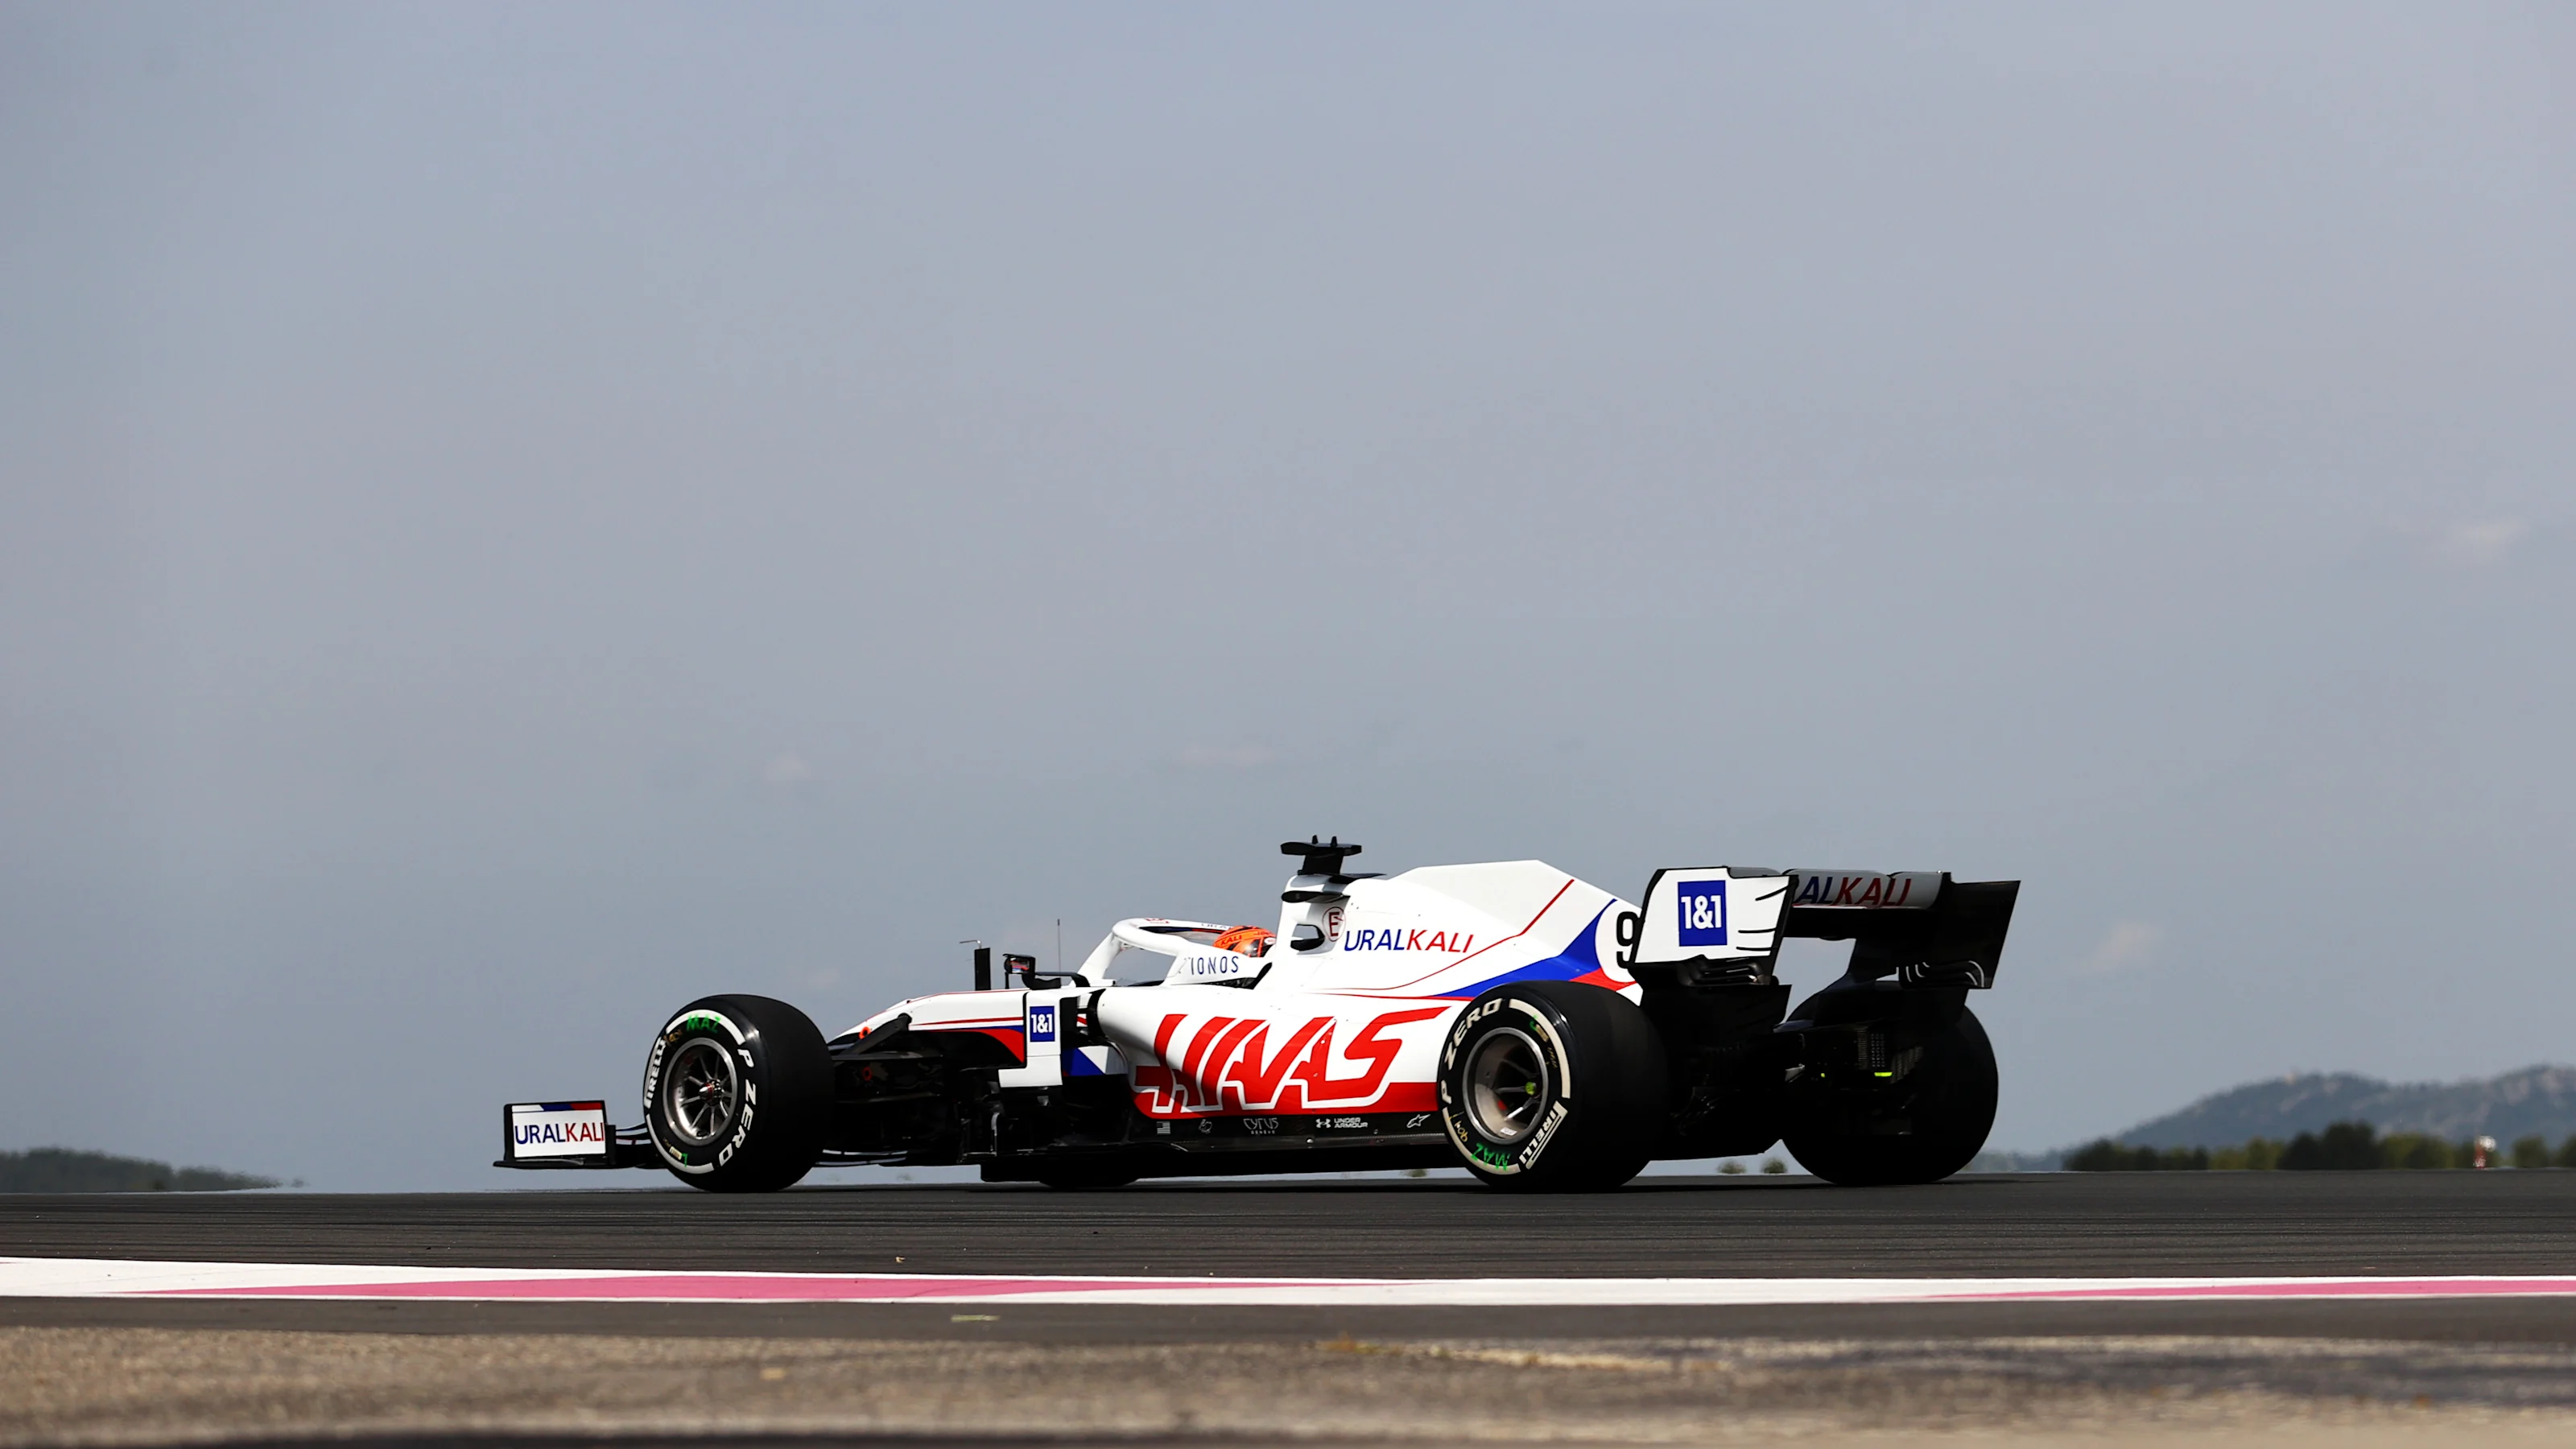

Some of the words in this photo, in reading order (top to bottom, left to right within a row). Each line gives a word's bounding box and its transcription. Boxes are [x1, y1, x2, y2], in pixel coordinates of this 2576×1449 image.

[1681, 894, 1723, 930] 1&1
[1344, 929, 1475, 953] URALKALI
[1616, 910, 1639, 969] 9
[1191, 956, 1240, 975] IONOS
[687, 1014, 722, 1034] MAZ
[1030, 1013, 1054, 1034] 1&1
[1444, 998, 1503, 1071] ZERO
[643, 1036, 667, 1109] PIRELLI
[737, 1049, 755, 1067] P
[1134, 1006, 1452, 1111] HAAS
[514, 1122, 605, 1145] URALKALI
[718, 1079, 757, 1167] ZERO
[1518, 1100, 1569, 1170] PIRELLI
